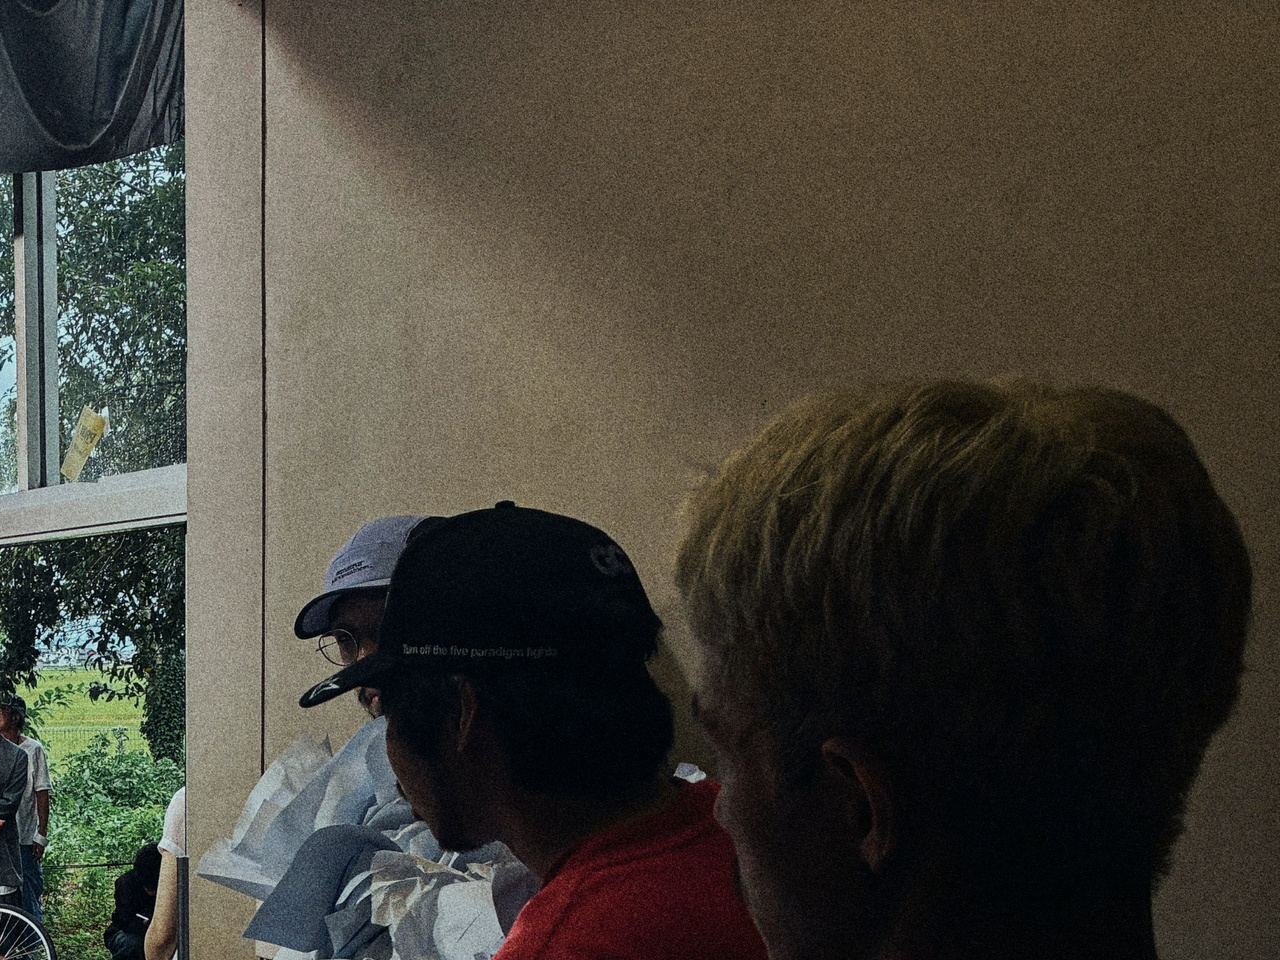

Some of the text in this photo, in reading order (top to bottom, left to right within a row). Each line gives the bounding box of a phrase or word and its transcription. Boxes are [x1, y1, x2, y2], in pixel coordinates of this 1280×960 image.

[420, 644, 431, 655] off
[433, 645, 447, 656] the
[450, 645, 468, 656] five
[470, 646, 524, 660] paradigm
